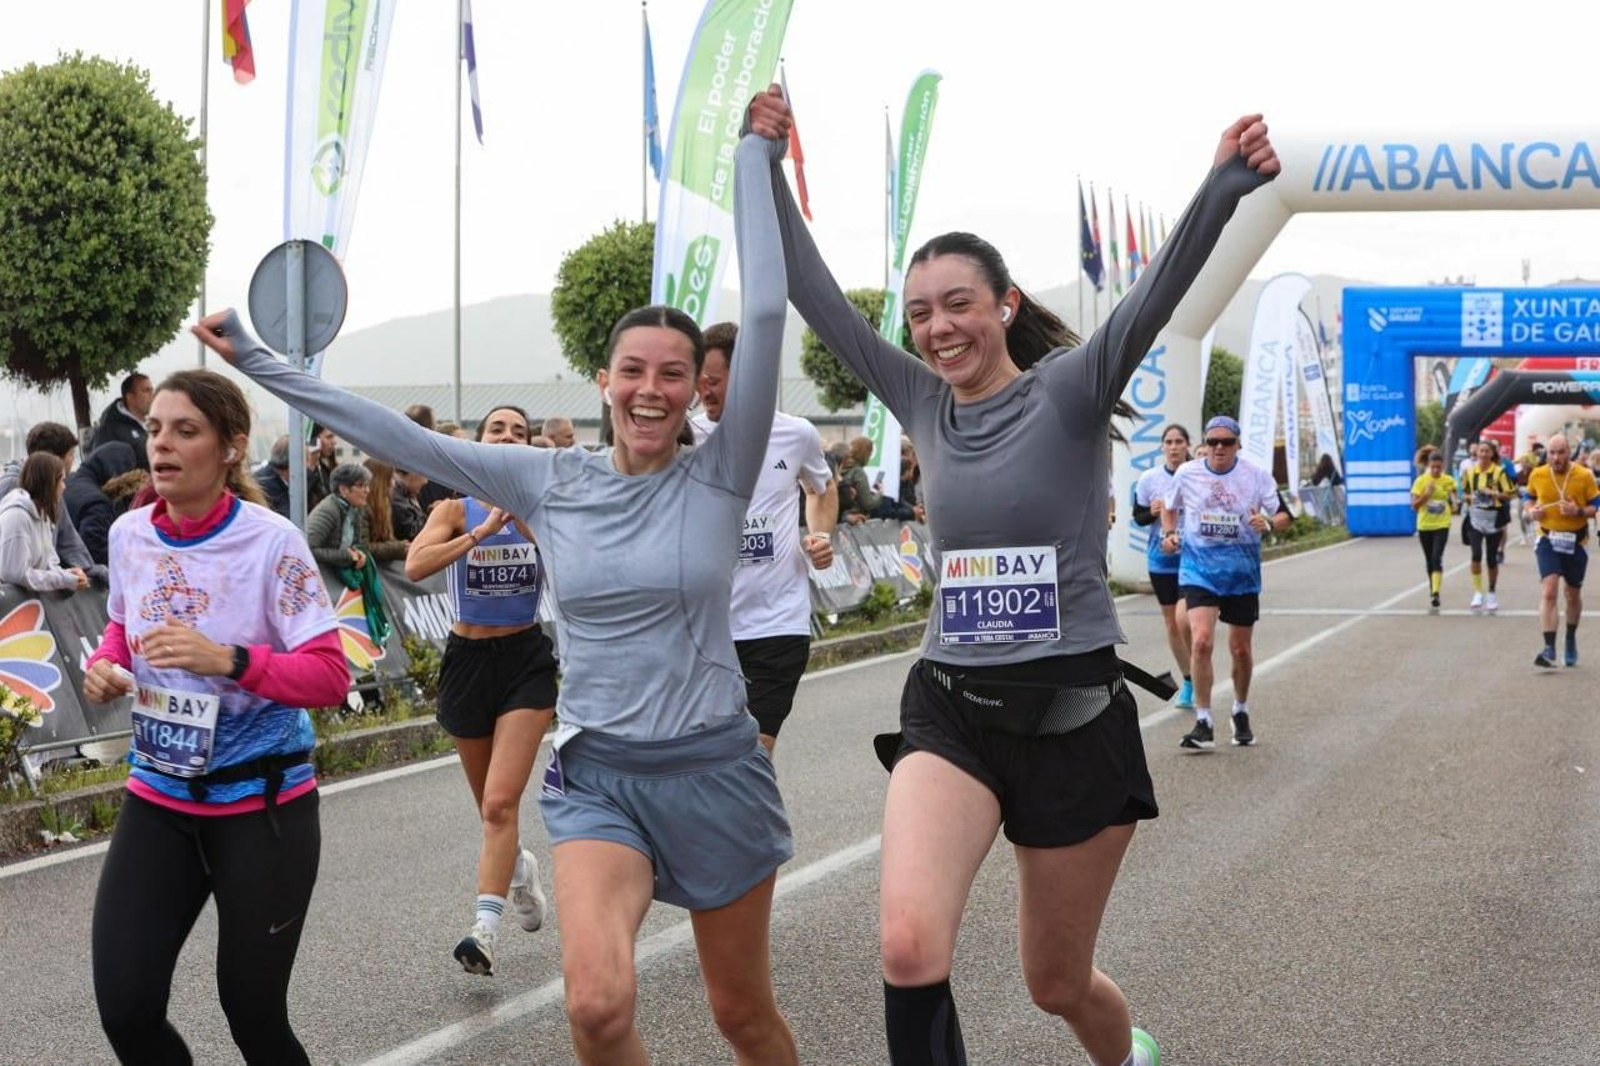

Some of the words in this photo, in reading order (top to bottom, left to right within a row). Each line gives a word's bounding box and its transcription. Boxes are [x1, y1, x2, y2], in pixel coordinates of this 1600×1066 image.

[700, 109, 716, 135] El
[709, 30, 736, 107] poder
[717, 143, 734, 165] la
[710, 169, 727, 202] de
[1512, 298, 1600, 318] XUNTA
[1512, 322, 1545, 343] DE
[472, 547, 530, 561] MINIBAY
[478, 566, 528, 582] 11874
[946, 554, 1045, 578] MINIBAY
[958, 587, 1041, 617] 11902
[976, 620, 1014, 629] CLAUDIA
[142, 719, 199, 753] 11844
